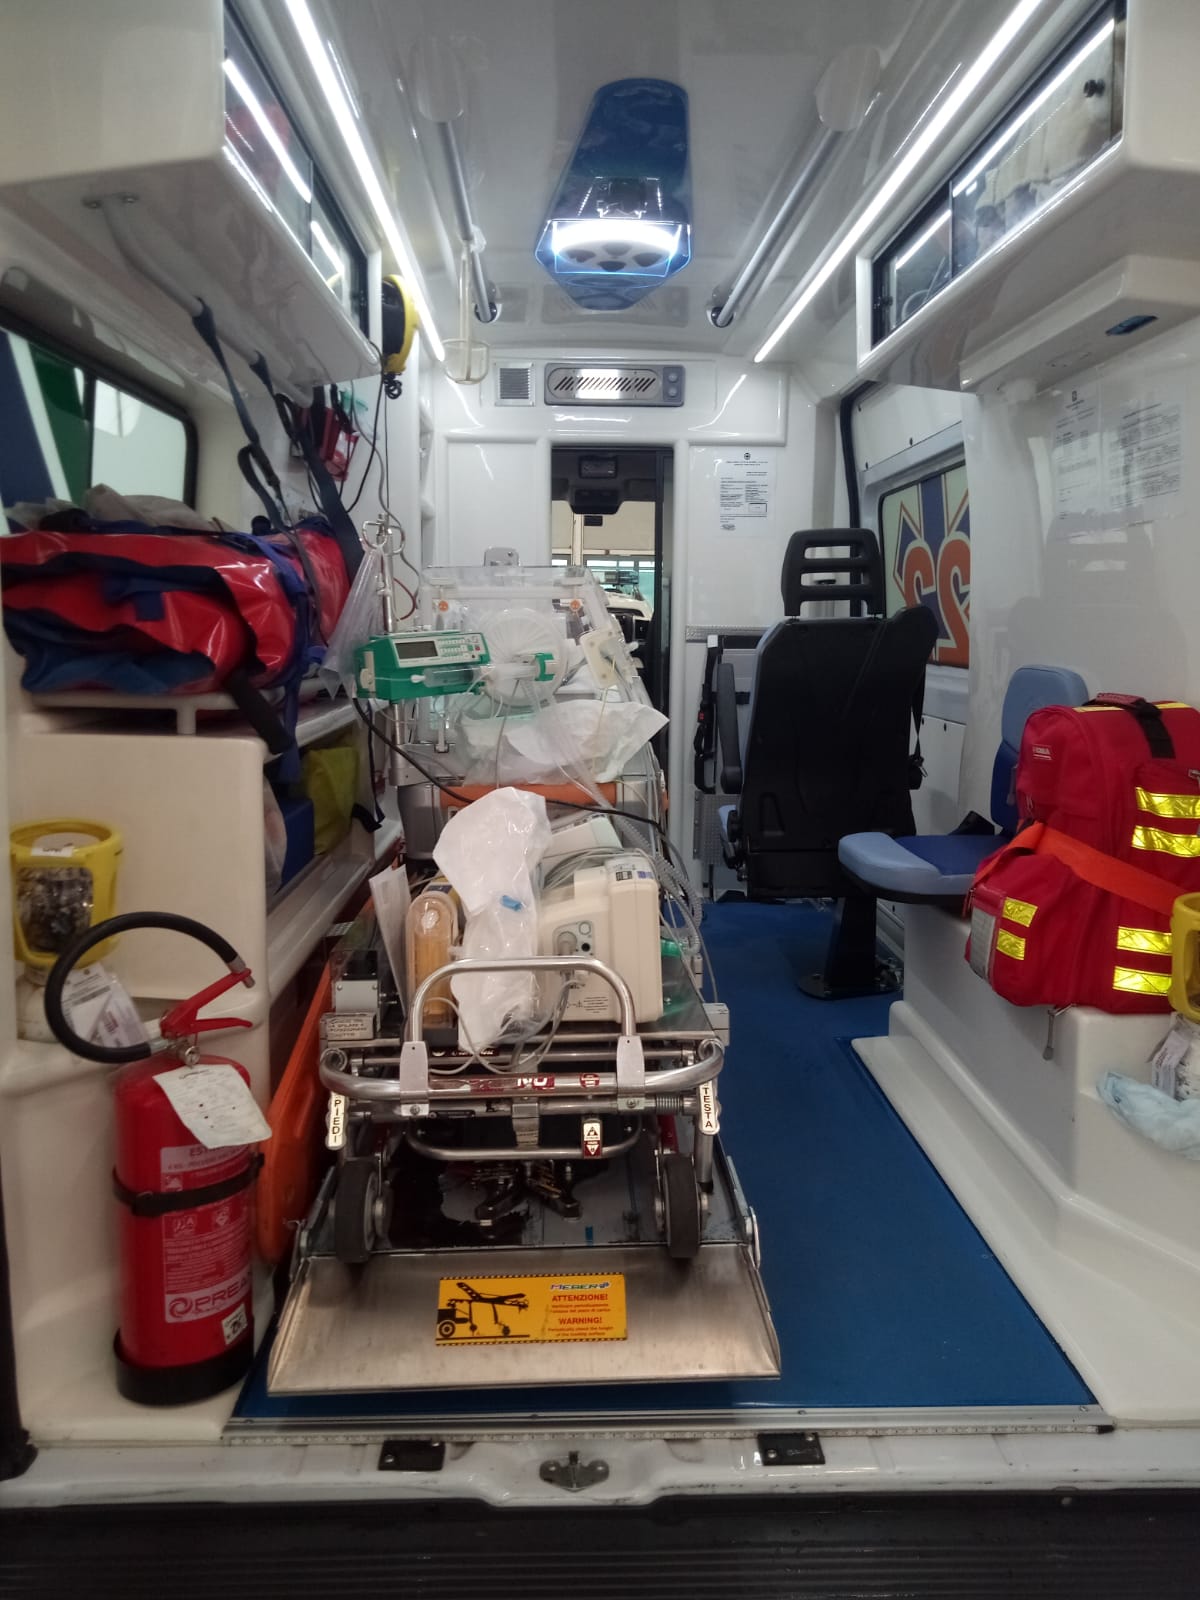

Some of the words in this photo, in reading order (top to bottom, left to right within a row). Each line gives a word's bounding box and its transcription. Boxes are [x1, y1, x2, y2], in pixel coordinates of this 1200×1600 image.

[702, 1087, 713, 1128] TESTA
[332, 1099, 342, 1143] PIEDI
[552, 1294, 608, 1302] ATTENZIONE!
[558, 1317, 602, 1325] WARNING!
